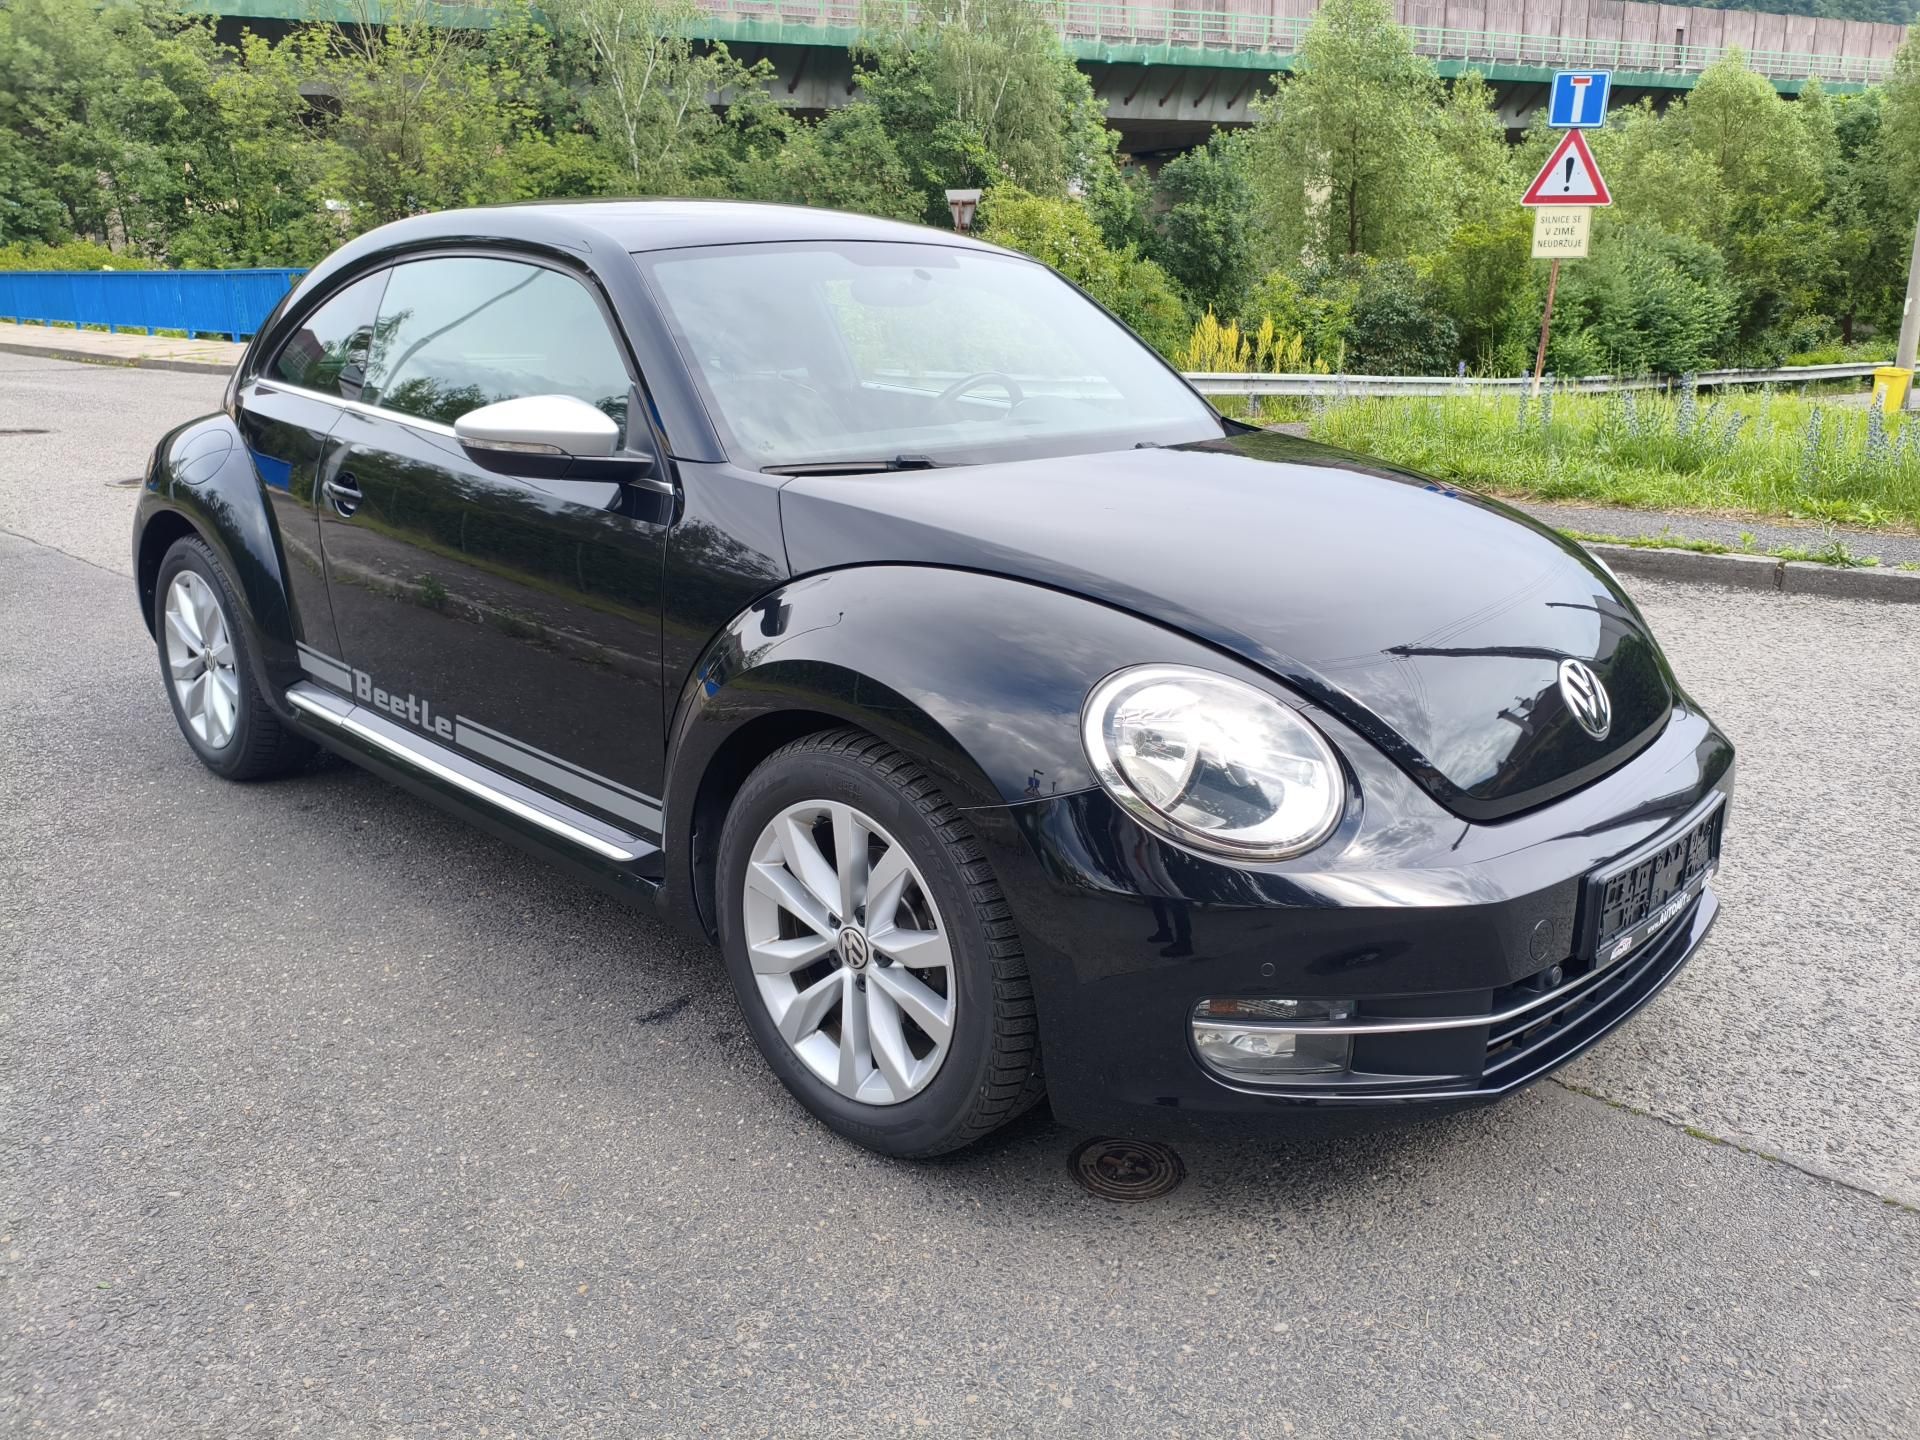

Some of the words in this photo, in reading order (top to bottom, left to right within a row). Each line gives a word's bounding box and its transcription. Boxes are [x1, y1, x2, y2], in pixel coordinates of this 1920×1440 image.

[1540, 215, 1569, 224] SILNICE
[1572, 215, 1582, 224] SE
[1545, 227, 1551, 236] V
[1537, 238, 1582, 248] NEUDRŽUJE
[352, 668, 454, 741] Beetle
